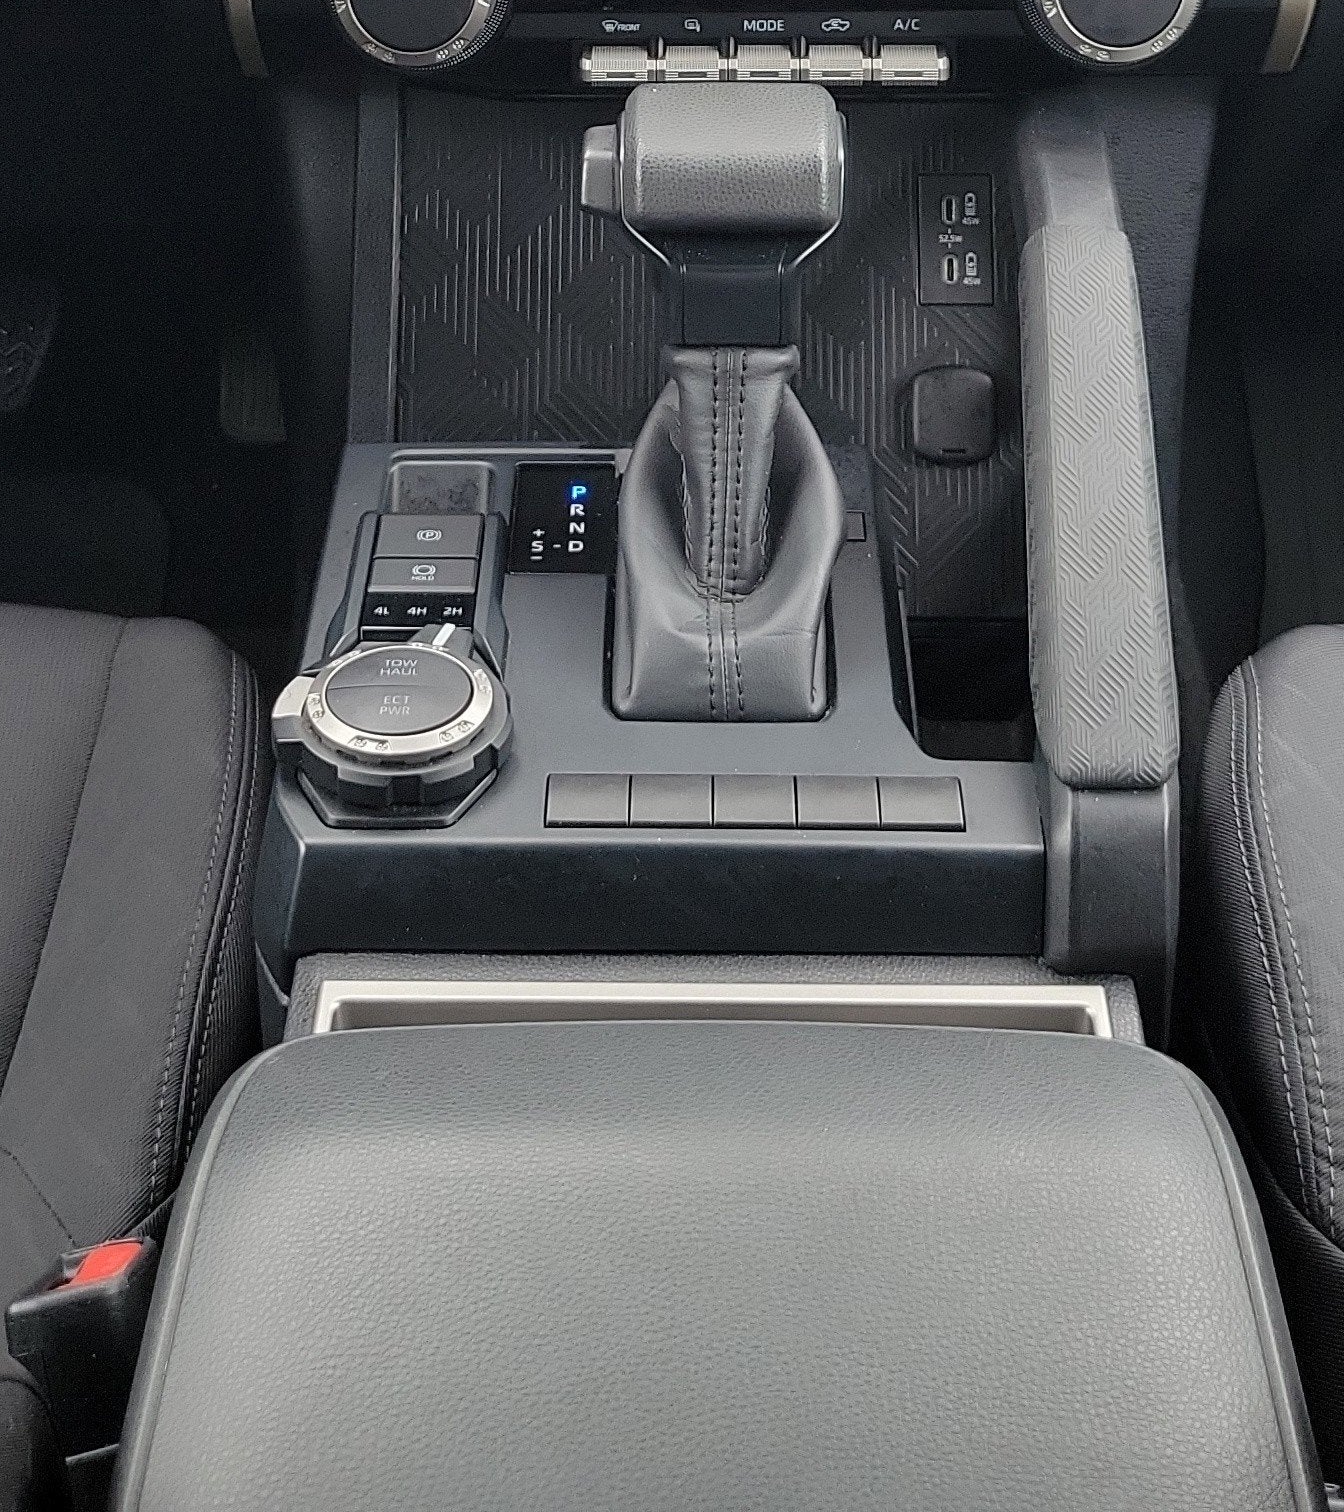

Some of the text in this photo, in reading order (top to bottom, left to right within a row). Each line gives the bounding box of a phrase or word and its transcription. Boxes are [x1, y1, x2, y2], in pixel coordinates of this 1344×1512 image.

[616, 22, 641, 32] FRONT
[743, 19, 785, 32] MODE
[893, 18, 921, 32] A/C
[572, 485, 587, 499] P
[569, 503, 585, 517] R
[569, 521, 585, 535] N
[530, 540, 544, 552] S
[567, 540, 584, 553] D
[372, 606, 463, 616] 4L 4H 2H
[384, 659, 418, 668] TOW
[379, 668, 418, 677] HAUL
[383, 695, 411, 705] ECT
[379, 705, 411, 716] PWR
